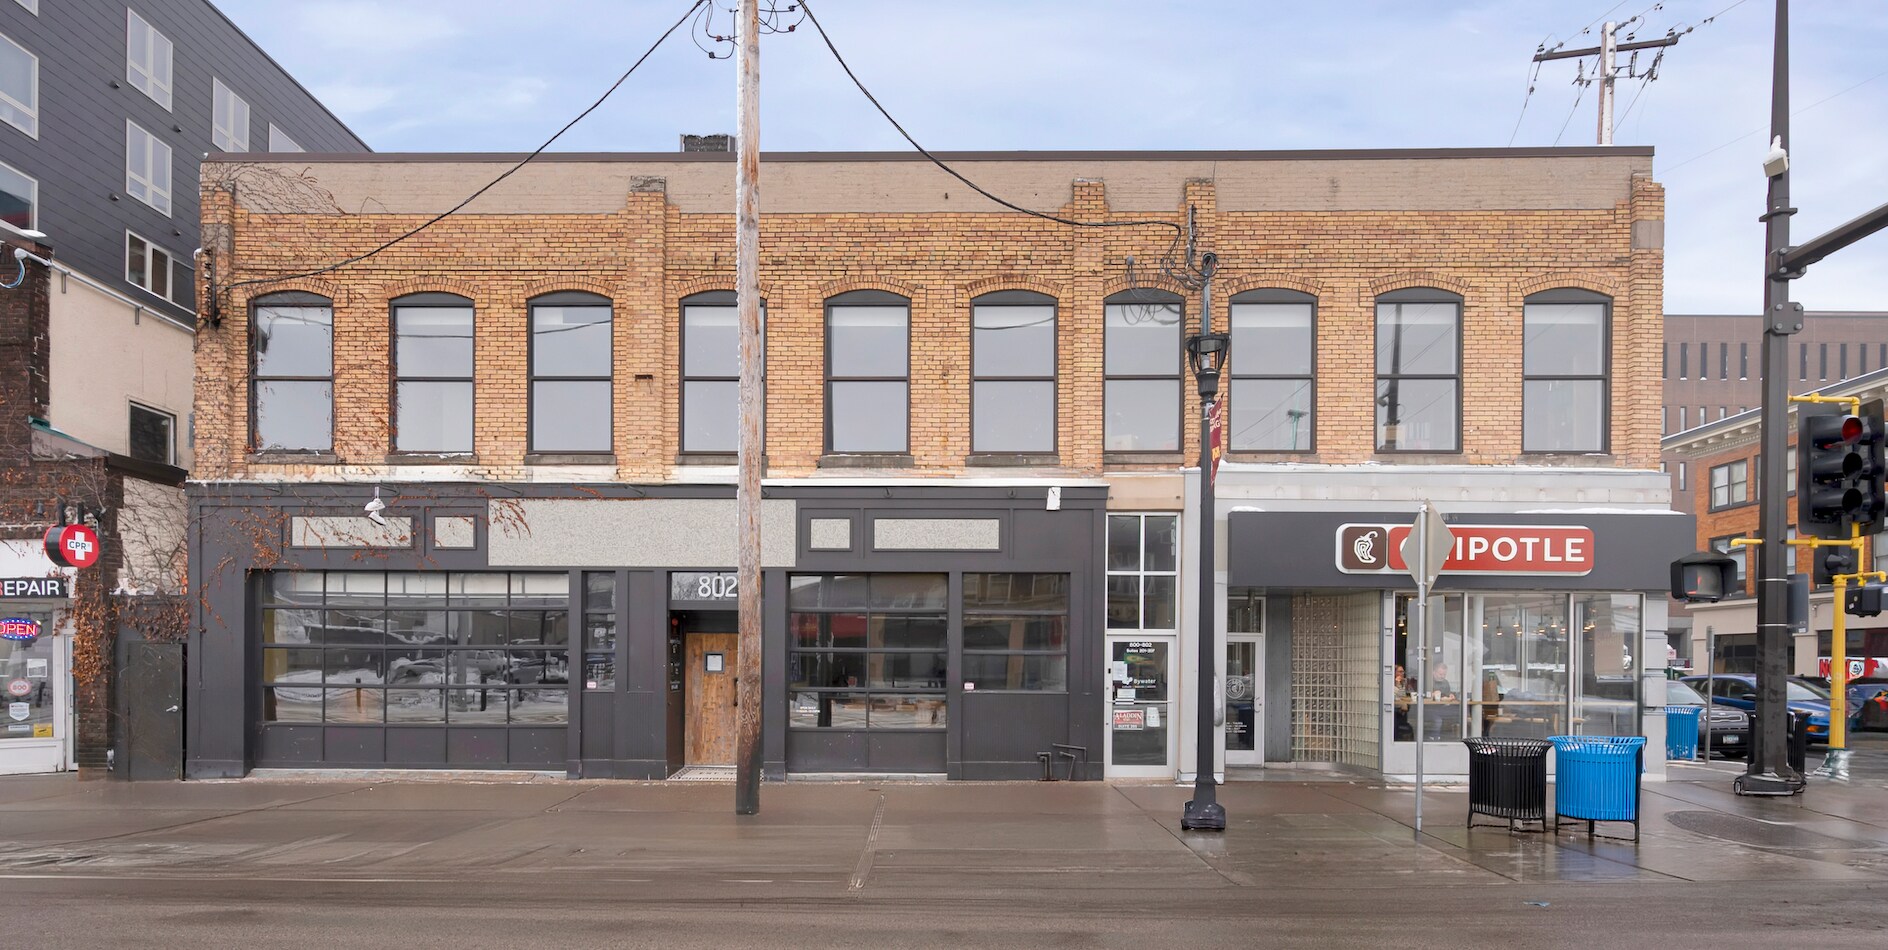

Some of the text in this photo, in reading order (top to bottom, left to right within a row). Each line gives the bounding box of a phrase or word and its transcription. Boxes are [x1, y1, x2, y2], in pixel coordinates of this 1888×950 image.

[69, 540, 87, 550] CPR
[1400, 536, 1585, 561] IPOTLE
[0, 580, 60, 596] EPAIR
[698, 576, 738, 598] 802
